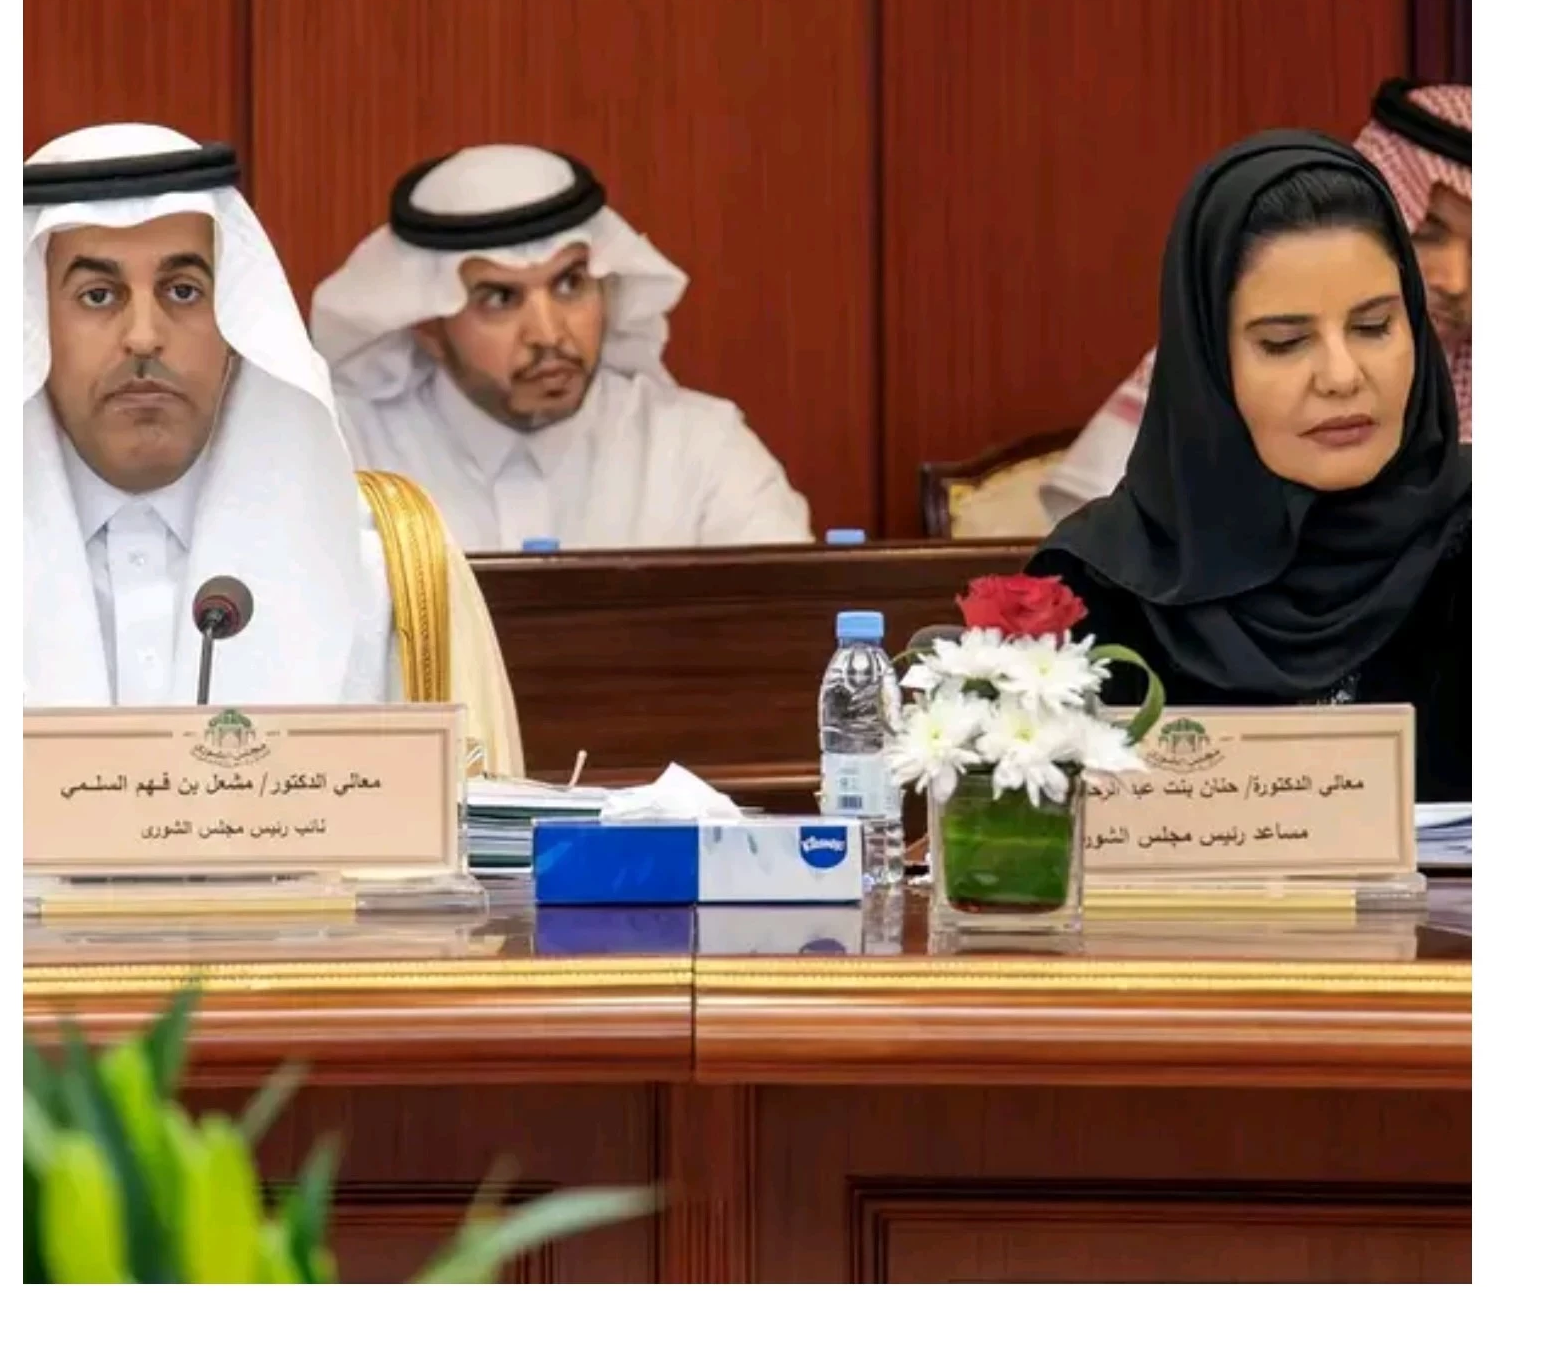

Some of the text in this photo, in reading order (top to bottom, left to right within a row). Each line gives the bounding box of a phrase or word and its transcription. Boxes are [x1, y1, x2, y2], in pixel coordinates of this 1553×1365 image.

[61, 775, 127, 799] السلمي
[178, 778, 199, 795] بن
[206, 773, 253, 794] مشعل
[333, 772, 382, 796] معالي
[1163, 779, 1193, 798] بنت
[1200, 778, 1239, 799] حنان
[1319, 775, 1364, 797] معالي
[142, 821, 192, 839] الشورى
[199, 820, 244, 839] مجلس
[250, 822, 288, 839] رئيس
[1085, 823, 1308, 849] مساعد رئيس مجلس الشور
